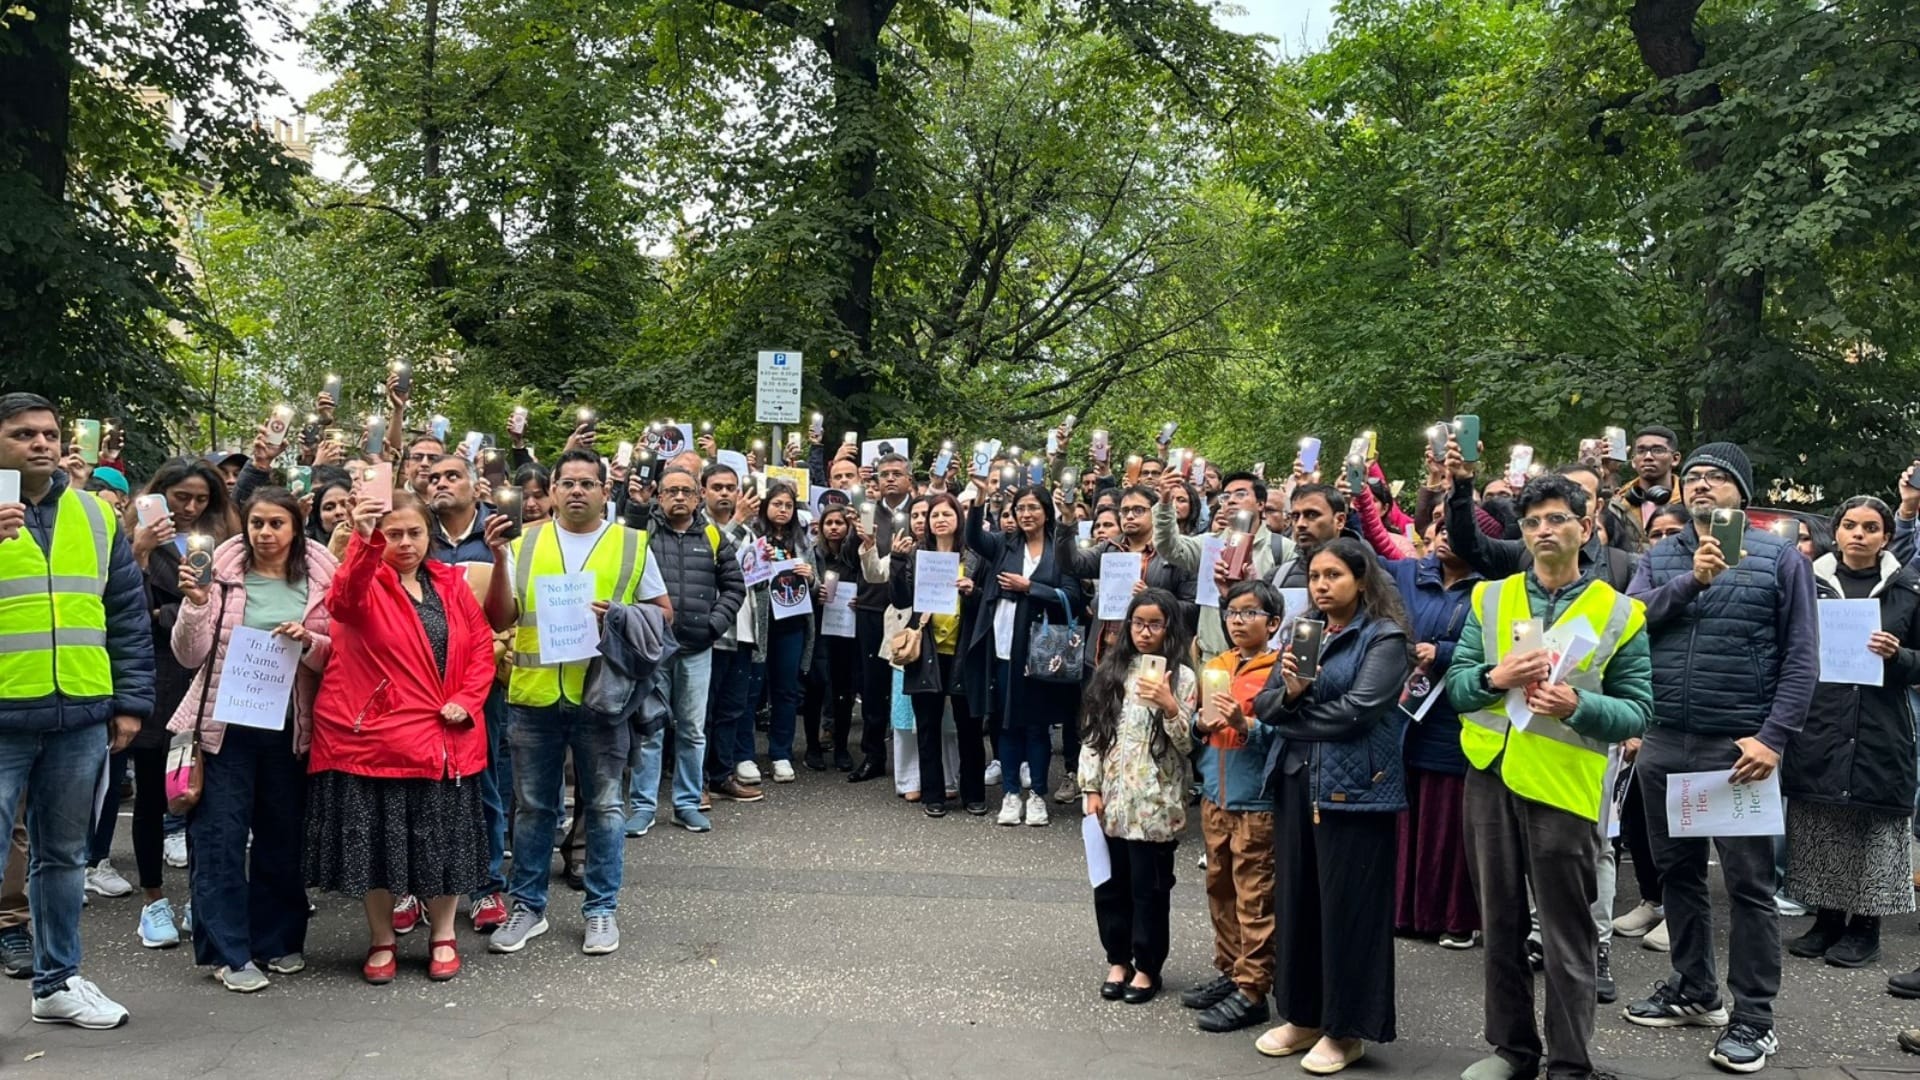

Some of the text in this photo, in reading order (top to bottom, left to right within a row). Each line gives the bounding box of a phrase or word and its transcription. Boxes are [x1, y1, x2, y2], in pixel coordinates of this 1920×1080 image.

[543, 584, 561, 593] "No
[549, 620, 588, 633] Demand
[246, 638, 287, 654] "In Her
[244, 653, 280, 670] Name,
[232, 665, 285, 684] We Stand
[246, 683, 263, 695] for
[228, 695, 274, 711] Justice!"
[1681, 778, 1693, 832] "Empower
[1732, 784, 1744, 819] Secur
